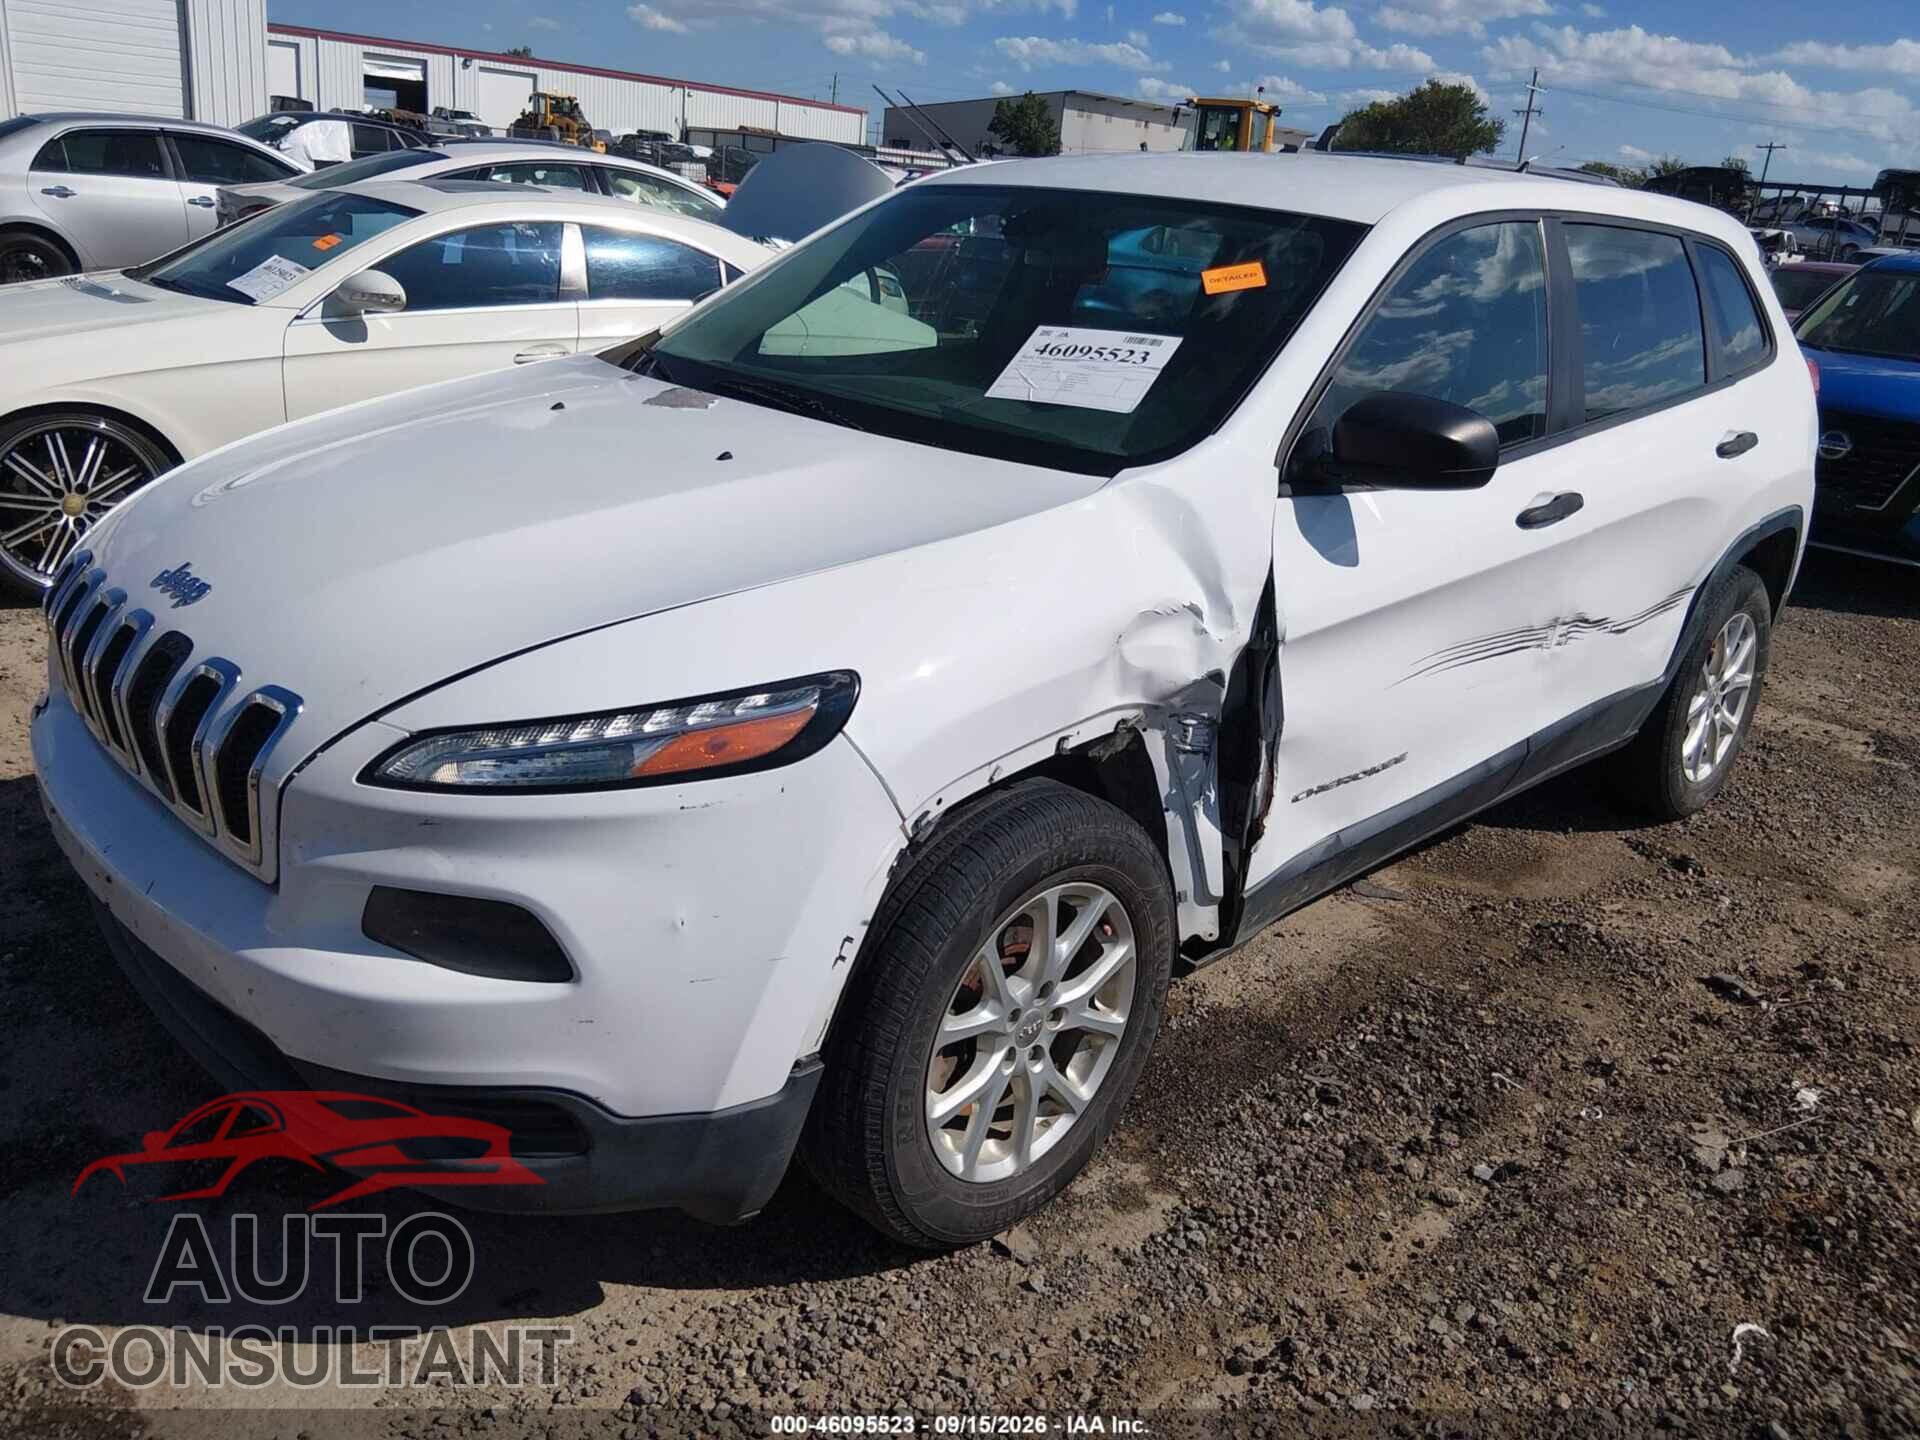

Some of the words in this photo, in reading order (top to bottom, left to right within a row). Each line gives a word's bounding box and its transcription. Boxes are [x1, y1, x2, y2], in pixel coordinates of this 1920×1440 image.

[1208, 271, 1258, 284] DETAILED
[1034, 342, 1151, 365] 46095523
[1291, 751, 1409, 804] CHEROKEE
